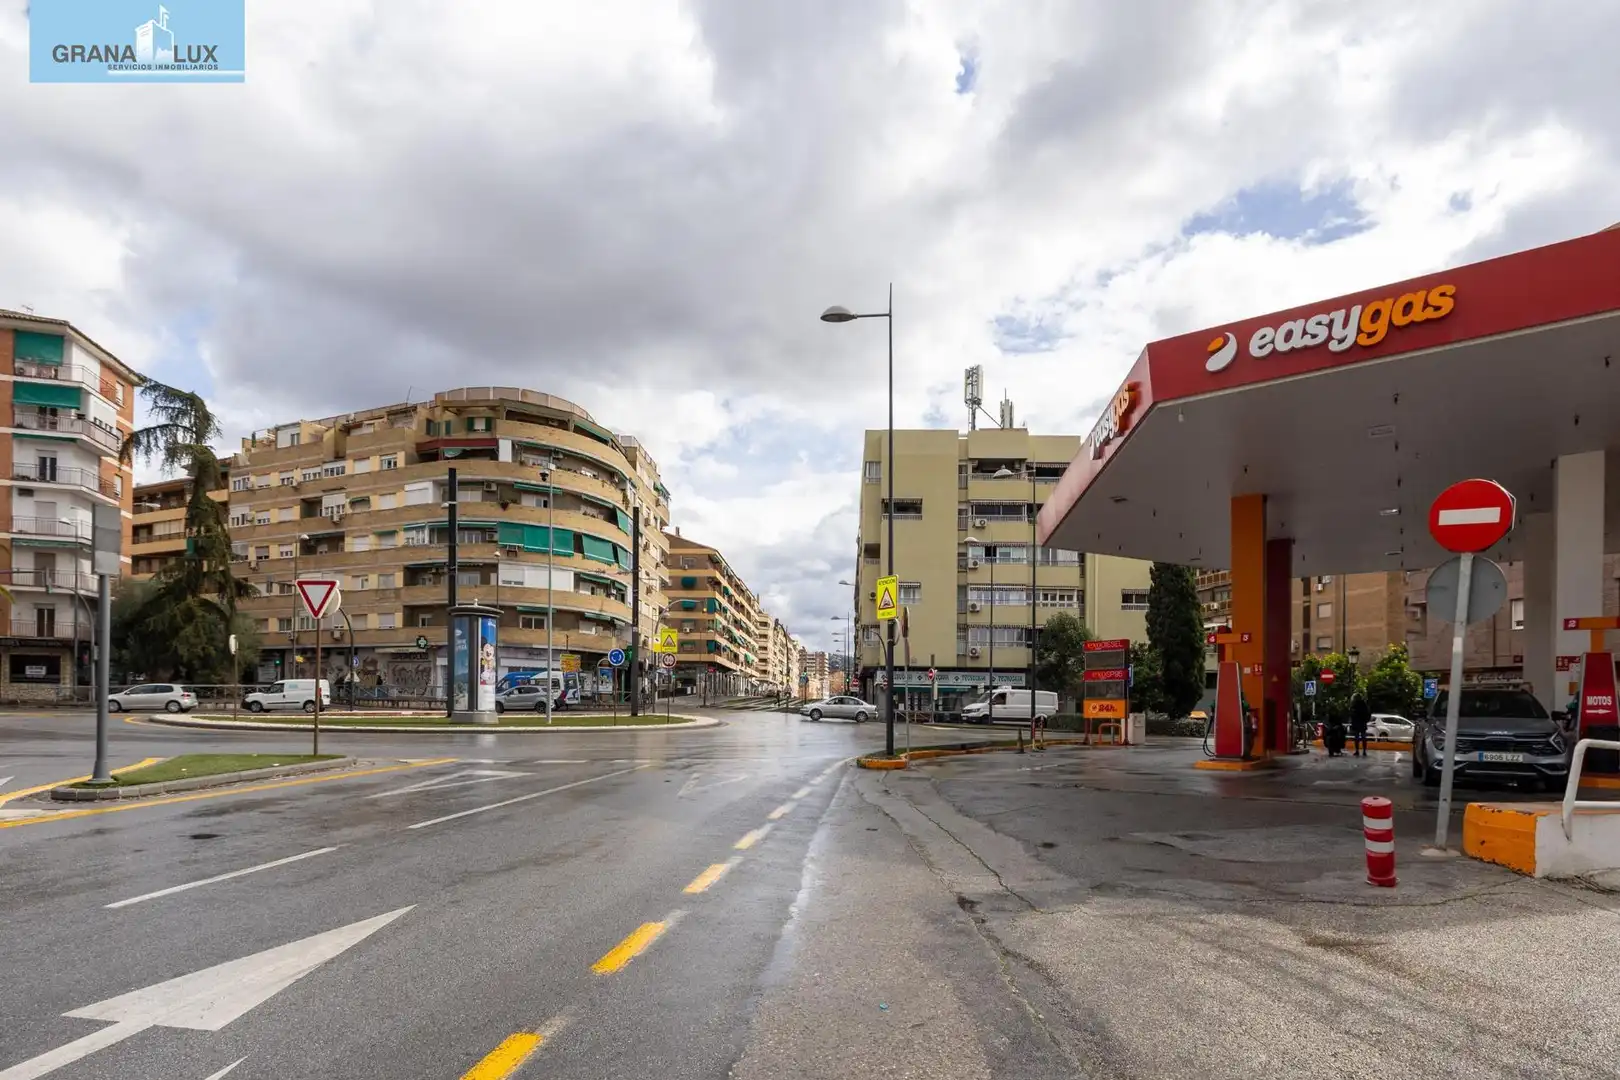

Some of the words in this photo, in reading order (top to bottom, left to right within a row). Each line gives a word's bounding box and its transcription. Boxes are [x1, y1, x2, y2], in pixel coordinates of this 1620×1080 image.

[1249, 284, 1457, 358] easygas
[1095, 383, 1130, 448] easygas
[1586, 696, 1612, 705] MOTOS
